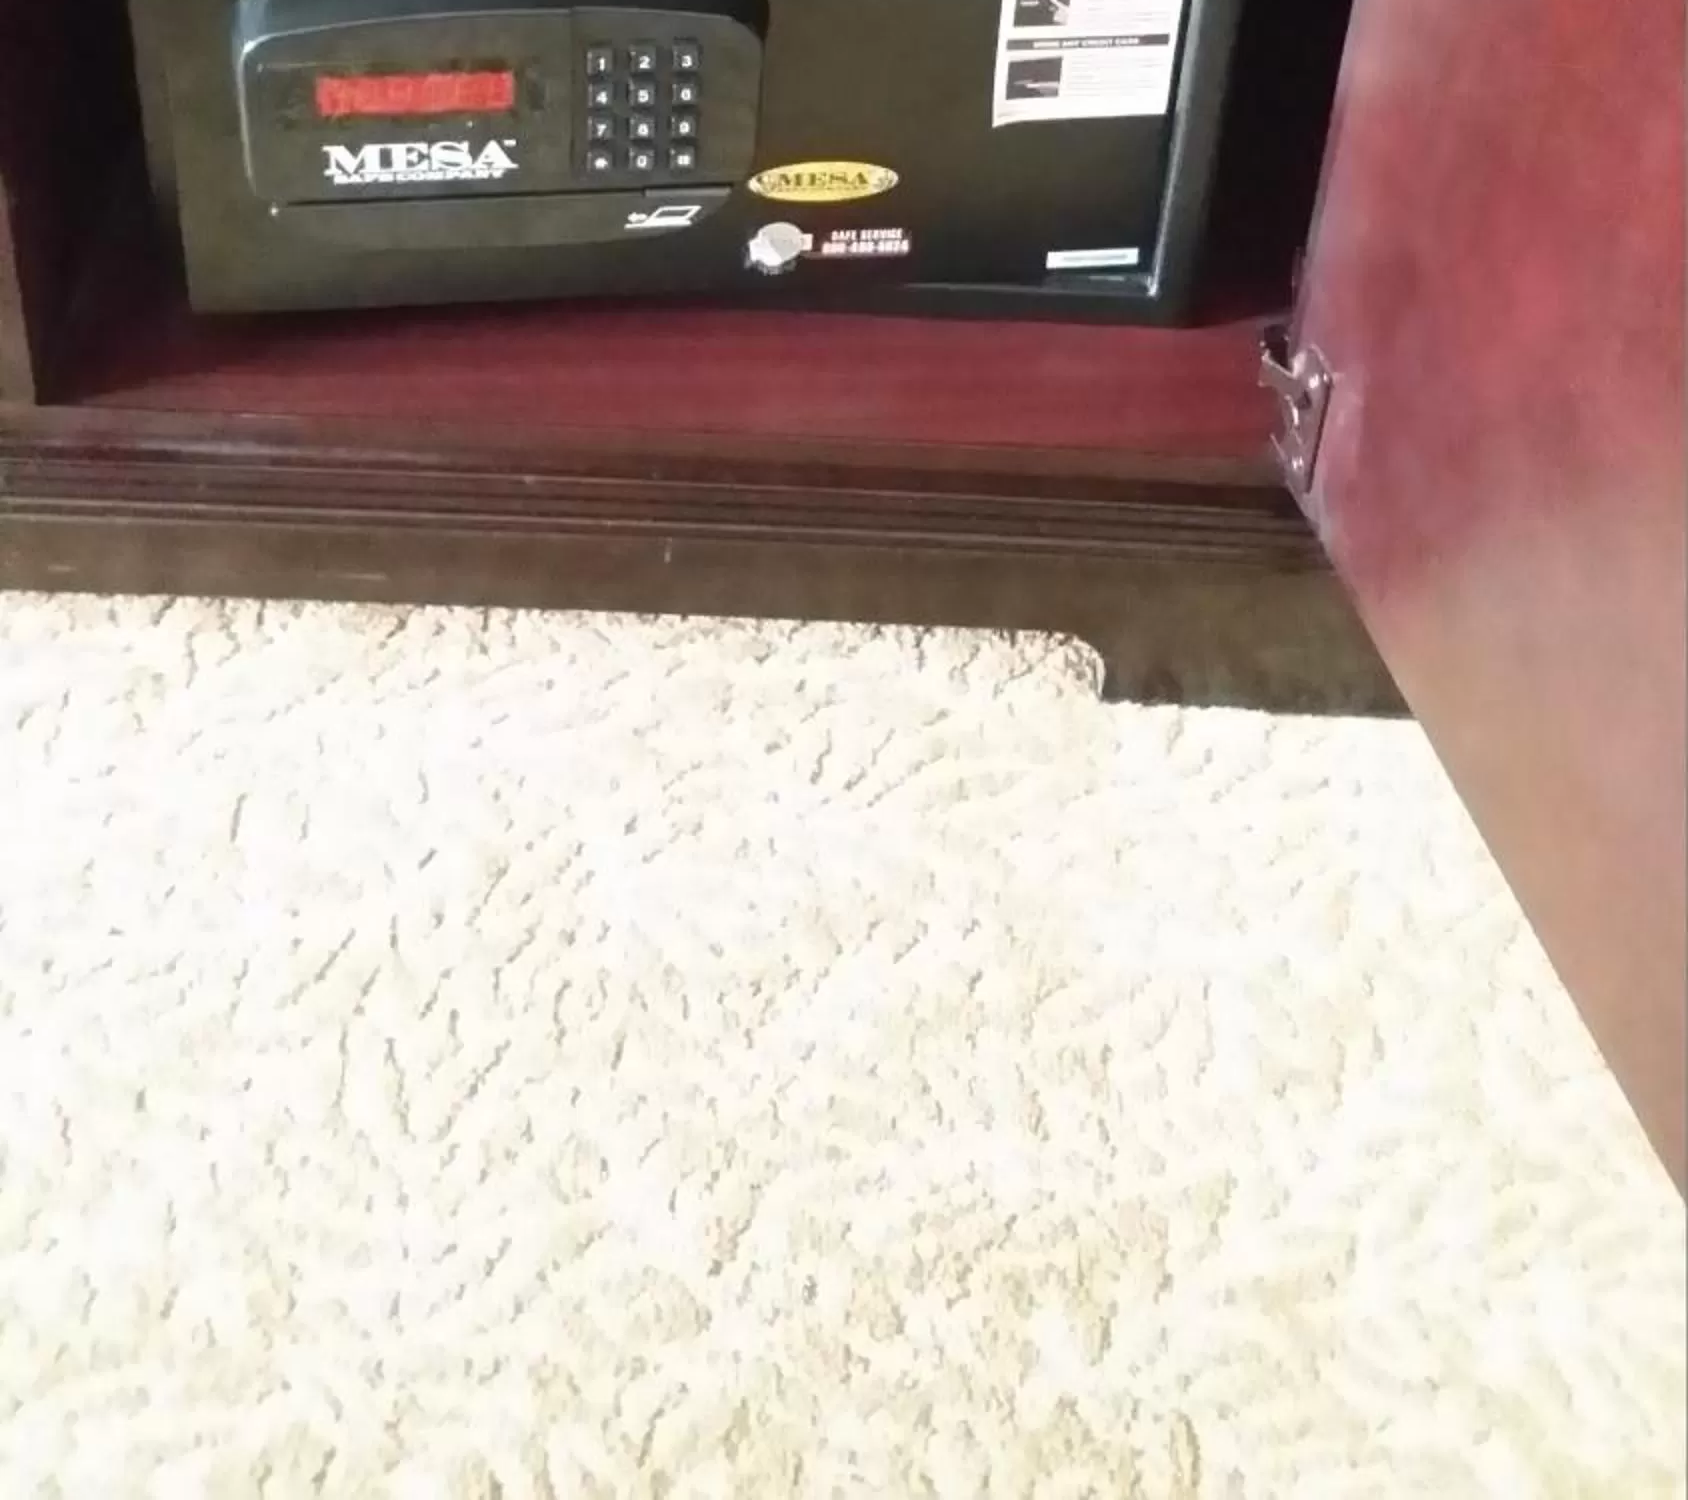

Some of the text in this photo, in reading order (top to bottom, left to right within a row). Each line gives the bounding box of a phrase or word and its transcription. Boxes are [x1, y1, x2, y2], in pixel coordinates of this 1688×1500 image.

[599, 57, 606, 71] 1
[639, 55, 650, 69] 2
[681, 54, 693, 68] 3
[595, 91, 608, 105] 4
[637, 88, 649, 103] 5
[596, 123, 607, 137] 7
[322, 138, 519, 177] MESA
[636, 155, 647, 169] 0
[779, 171, 869, 187] MESA
